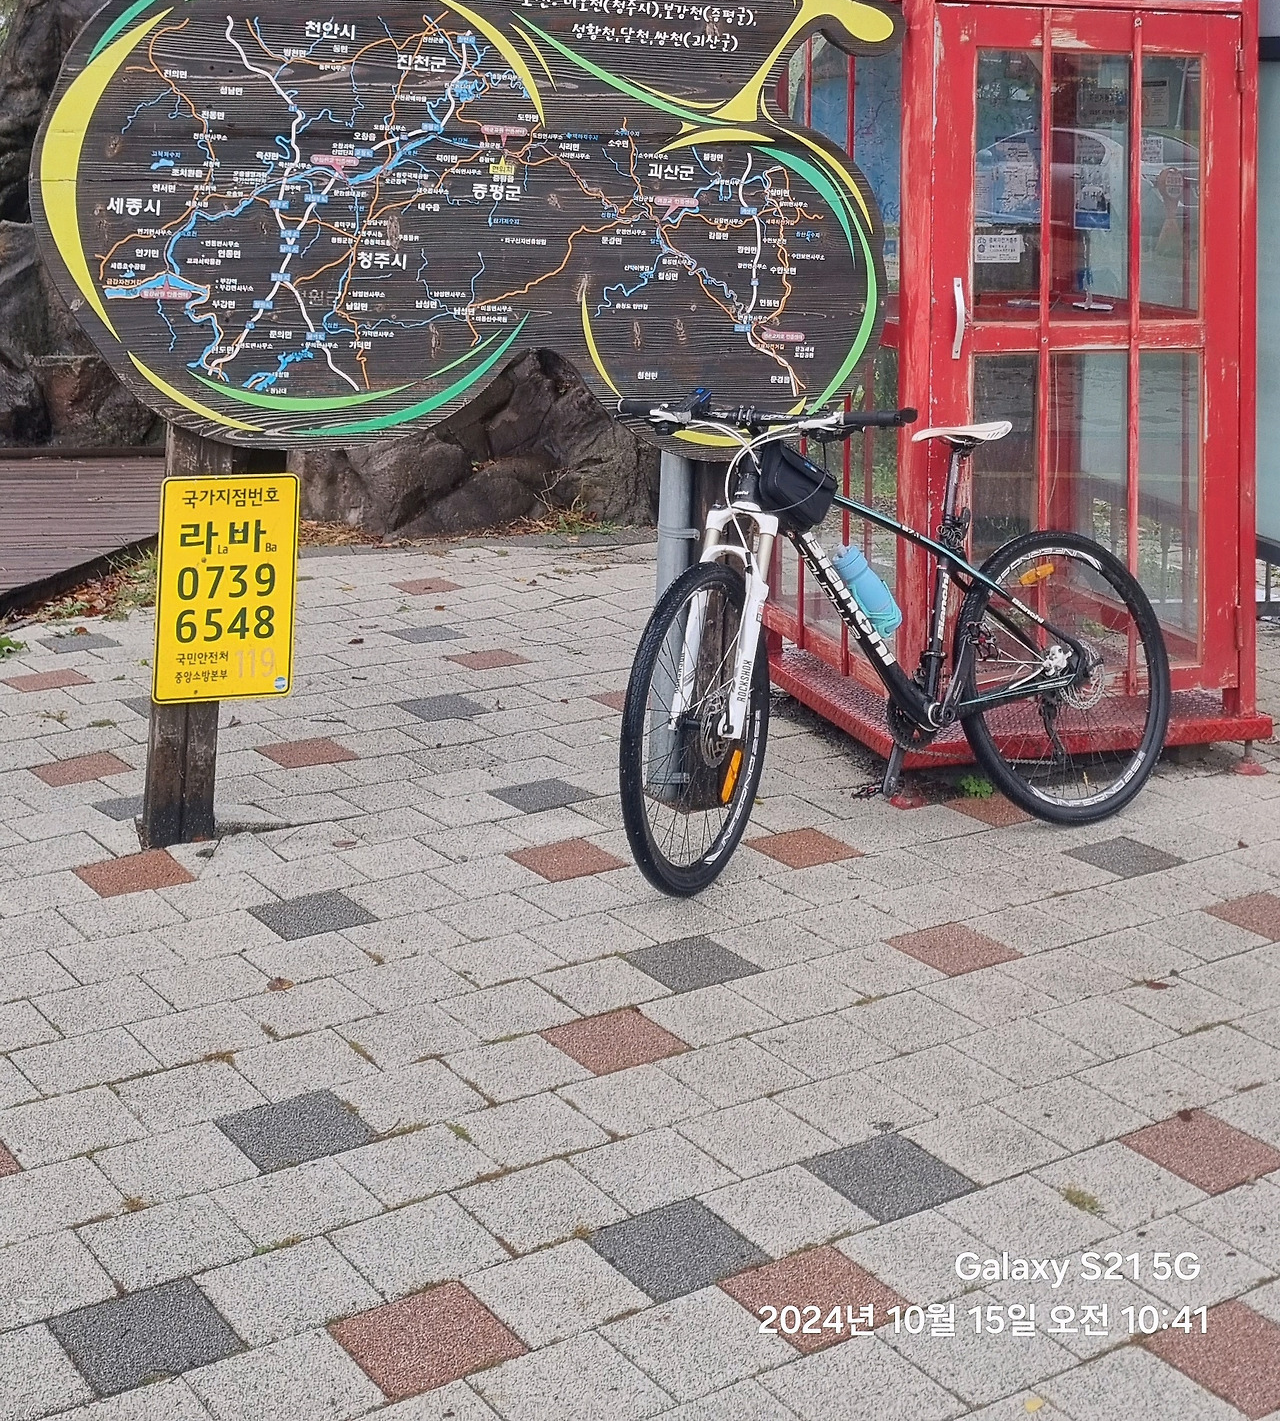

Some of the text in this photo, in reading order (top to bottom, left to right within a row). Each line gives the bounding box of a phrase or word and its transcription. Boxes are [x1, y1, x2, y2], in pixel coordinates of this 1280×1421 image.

[305, 20, 356, 40] 천안시
[397, 54, 446, 72] 진천군
[648, 163, 694, 180] 괴산군
[472, 183, 521, 201] 증평군
[107, 197, 161, 216] 세종시
[357, 251, 407, 270] 청주시
[182, 487, 280, 509] 국가지점번호
[179, 519, 277, 555] 라 La 바 Ba
[177, 562, 276, 601] 0739
[802, 531, 896, 667] Bianchi
[1011, 596, 1045, 624] Bianchi
[175, 605, 275, 644] 6548
[175, 647, 275, 679] 국민안전처 119
[174, 669, 228, 684] 중앙소방본부
[737, 659, 753, 704] ROCKSHOX
